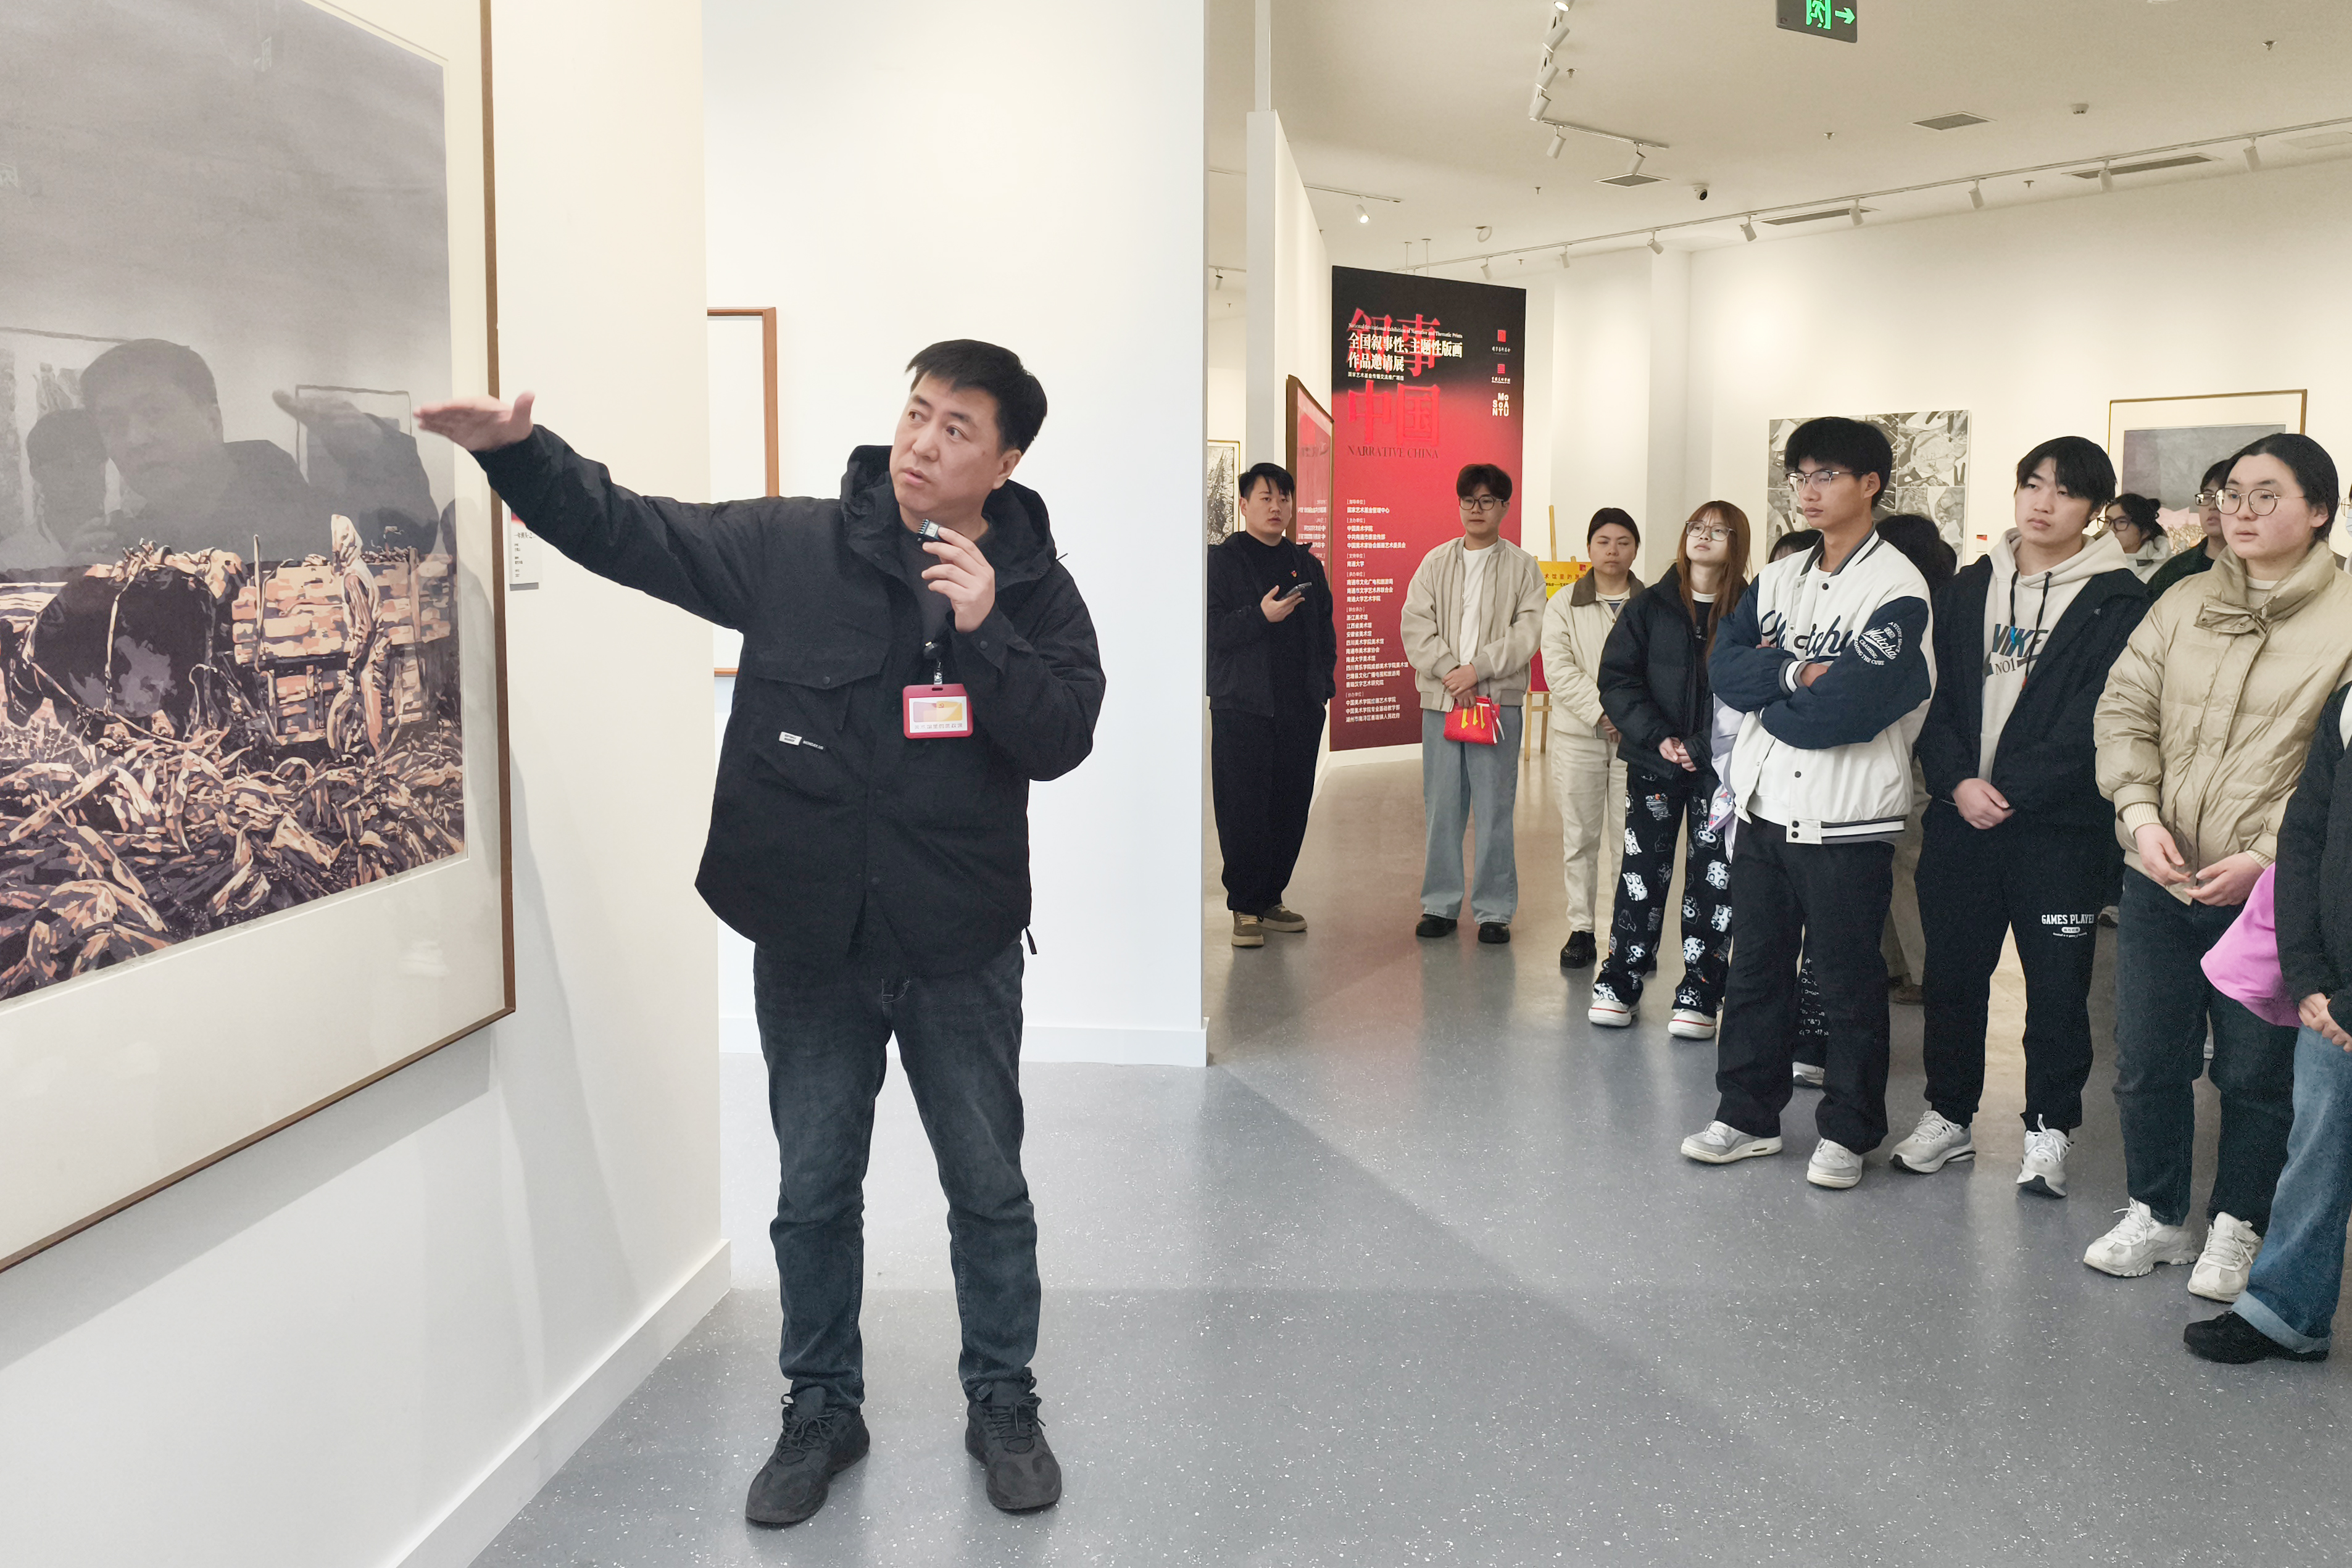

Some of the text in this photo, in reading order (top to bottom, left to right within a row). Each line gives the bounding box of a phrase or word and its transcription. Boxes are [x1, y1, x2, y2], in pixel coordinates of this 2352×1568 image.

[1348, 332, 1463, 359] 全国叙事性、主题性版画
[1348, 351, 1405, 372] 作品邀请展
[1348, 379, 1440, 447] 中国
[1348, 445, 1439, 459] NARRATIVE CHINA
[2042, 915, 2068, 924] GAMES
